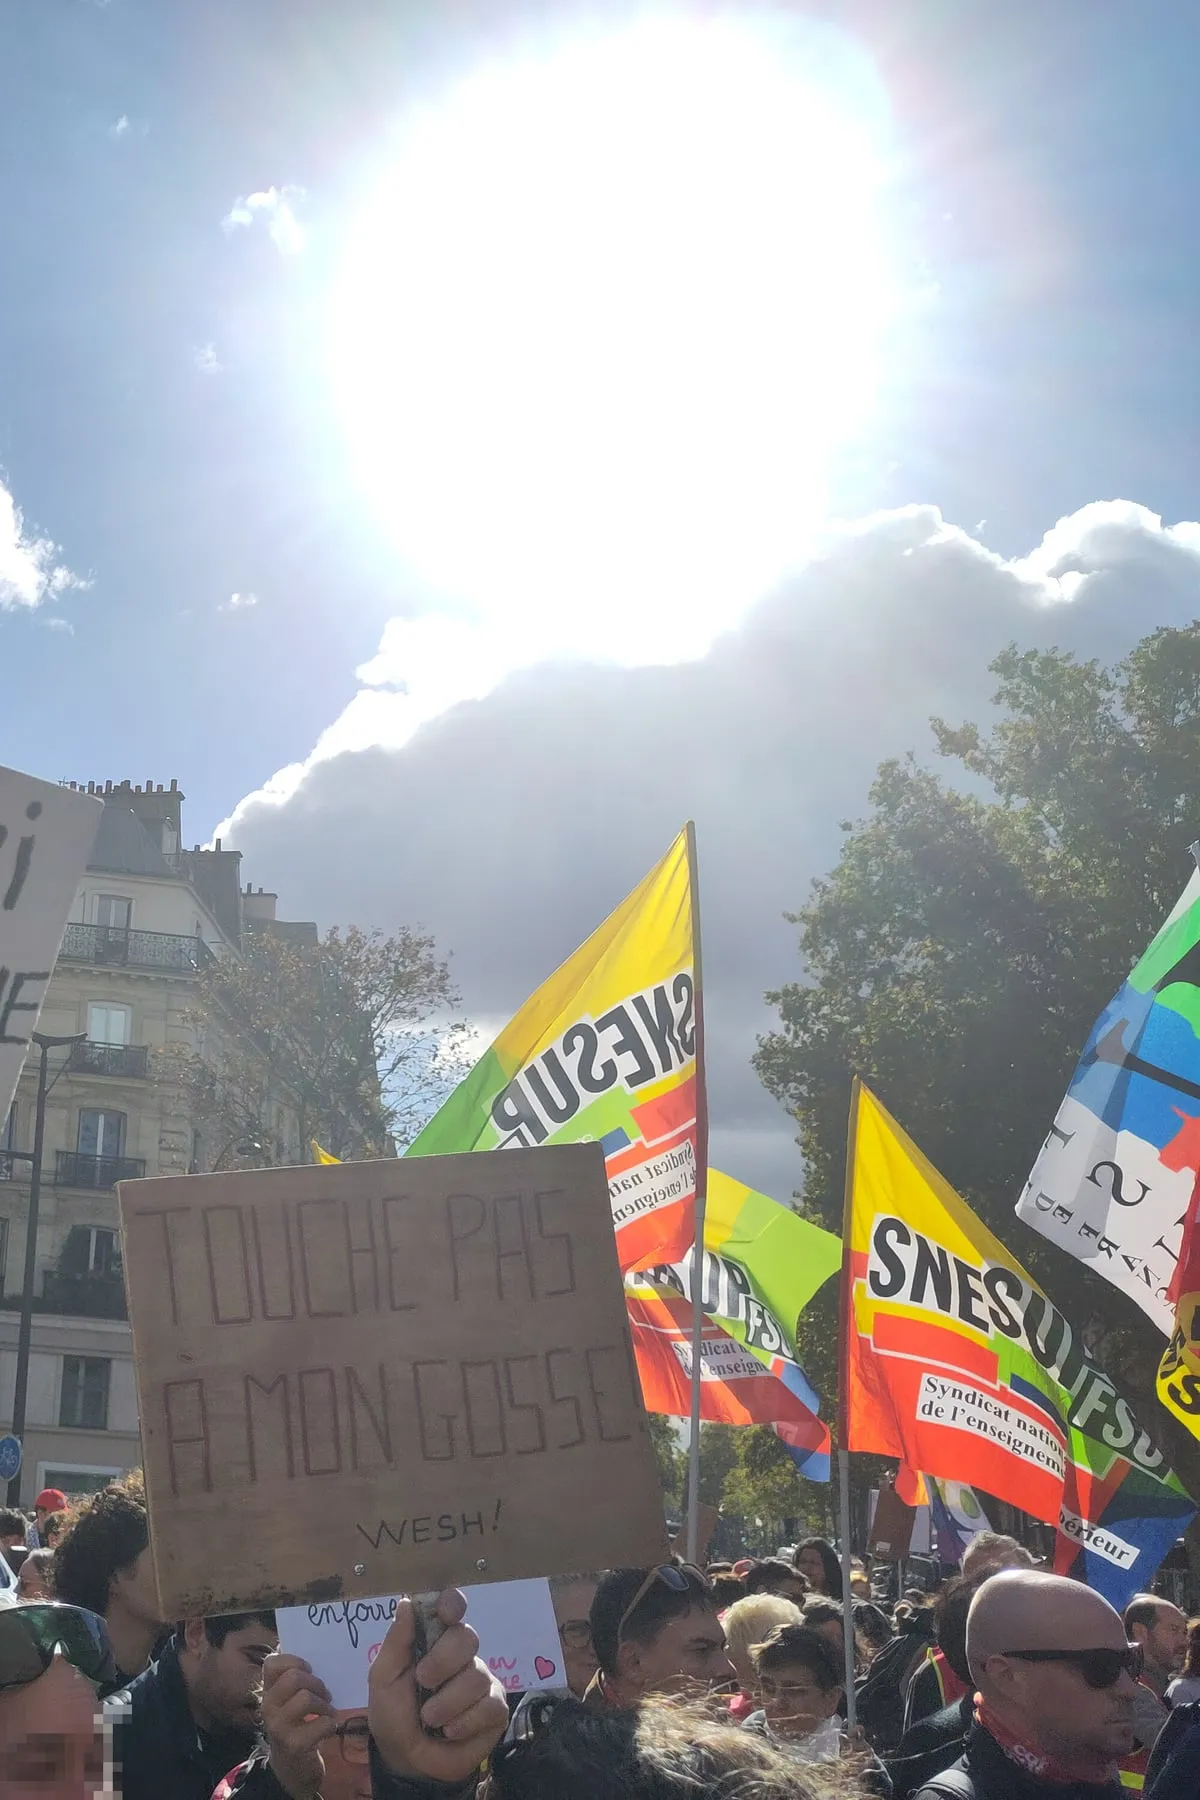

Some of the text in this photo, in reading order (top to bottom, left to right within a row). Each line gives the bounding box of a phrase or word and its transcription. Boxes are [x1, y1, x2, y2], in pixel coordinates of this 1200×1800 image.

[135, 1195, 418, 1327] TOUCHE
[445, 1188, 578, 1303] PAS
[673, 1341, 736, 1357] Sydicat
[921, 1400, 945, 1418] de
[925, 1376, 1011, 1422] Syndicat
[243, 1362, 397, 1484] MON
